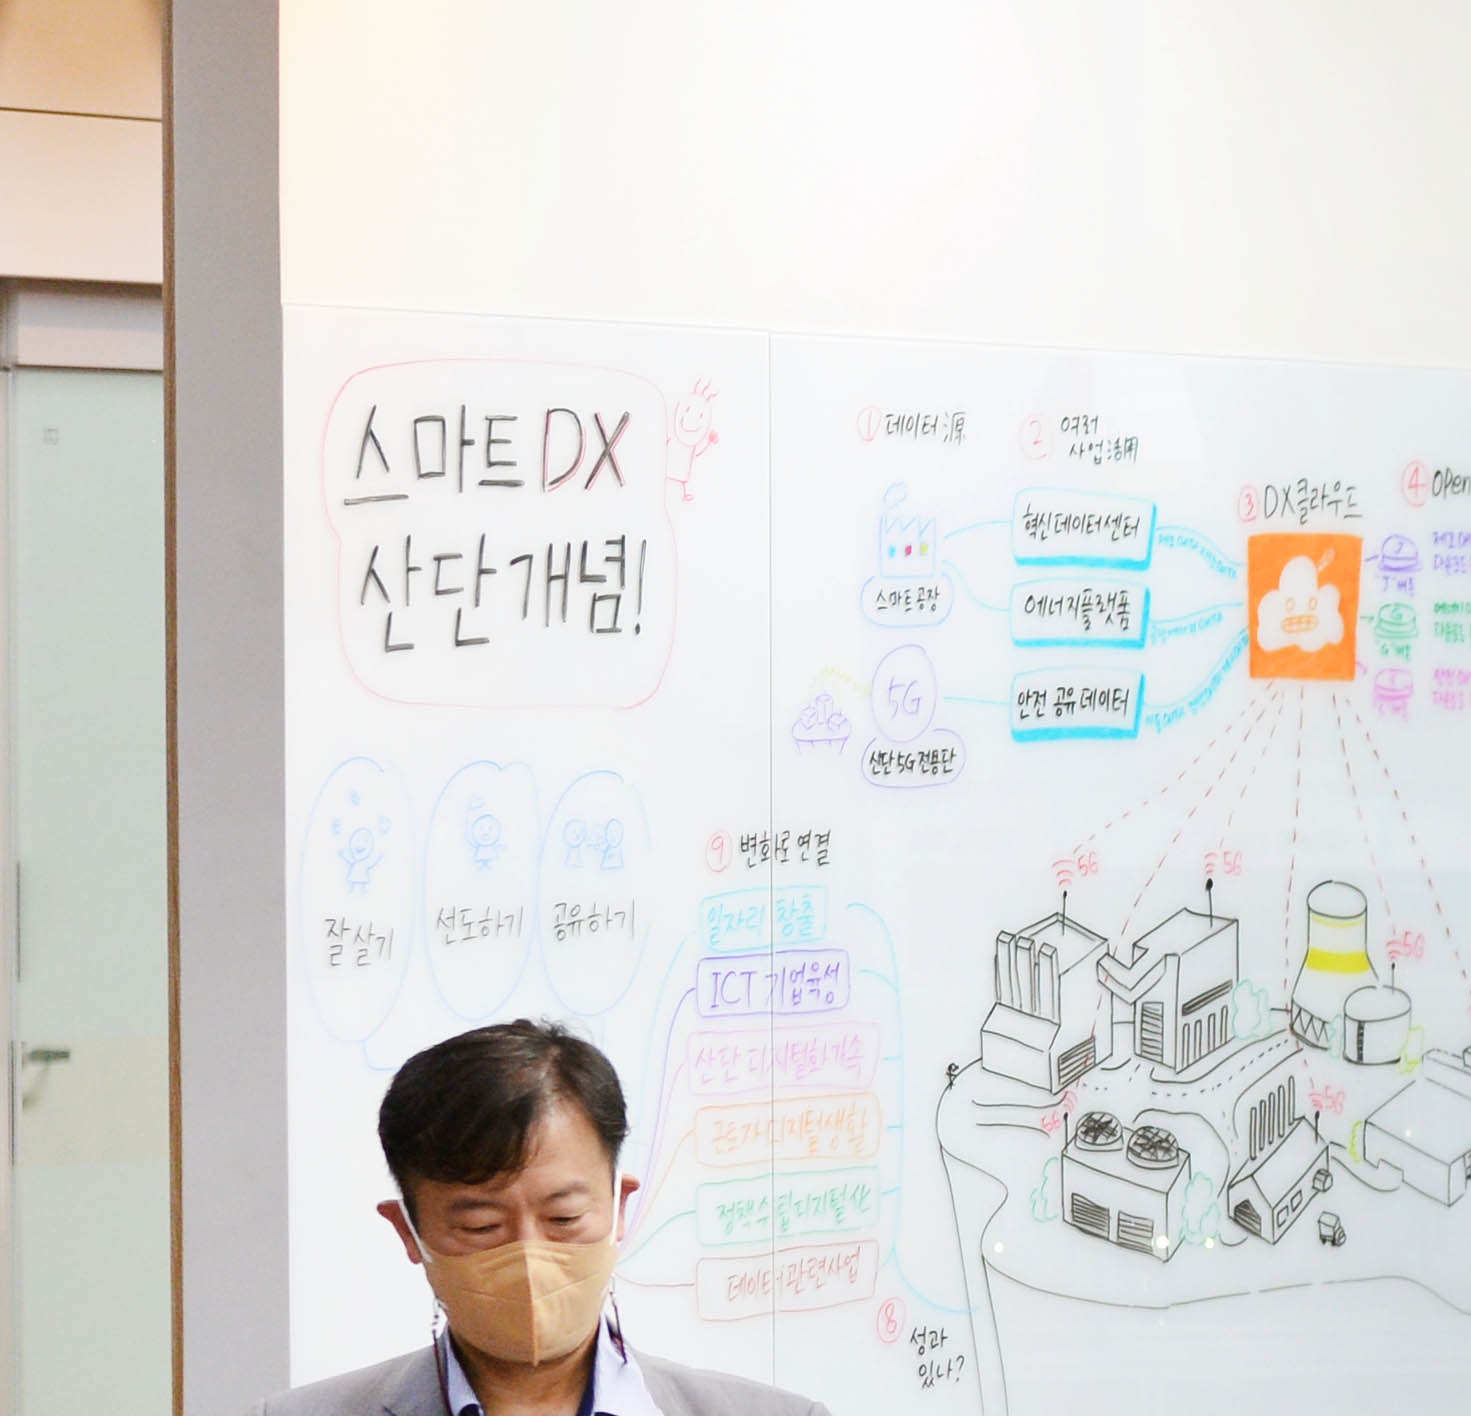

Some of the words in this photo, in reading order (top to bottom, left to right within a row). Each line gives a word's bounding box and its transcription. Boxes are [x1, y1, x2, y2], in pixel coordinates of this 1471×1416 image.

[343, 404, 526, 506] 스마트
[542, 406, 631, 493] DX
[359, 532, 498, 653] 산단
[889, 677, 922, 719] 5G
[710, 970, 759, 1010] ICT
